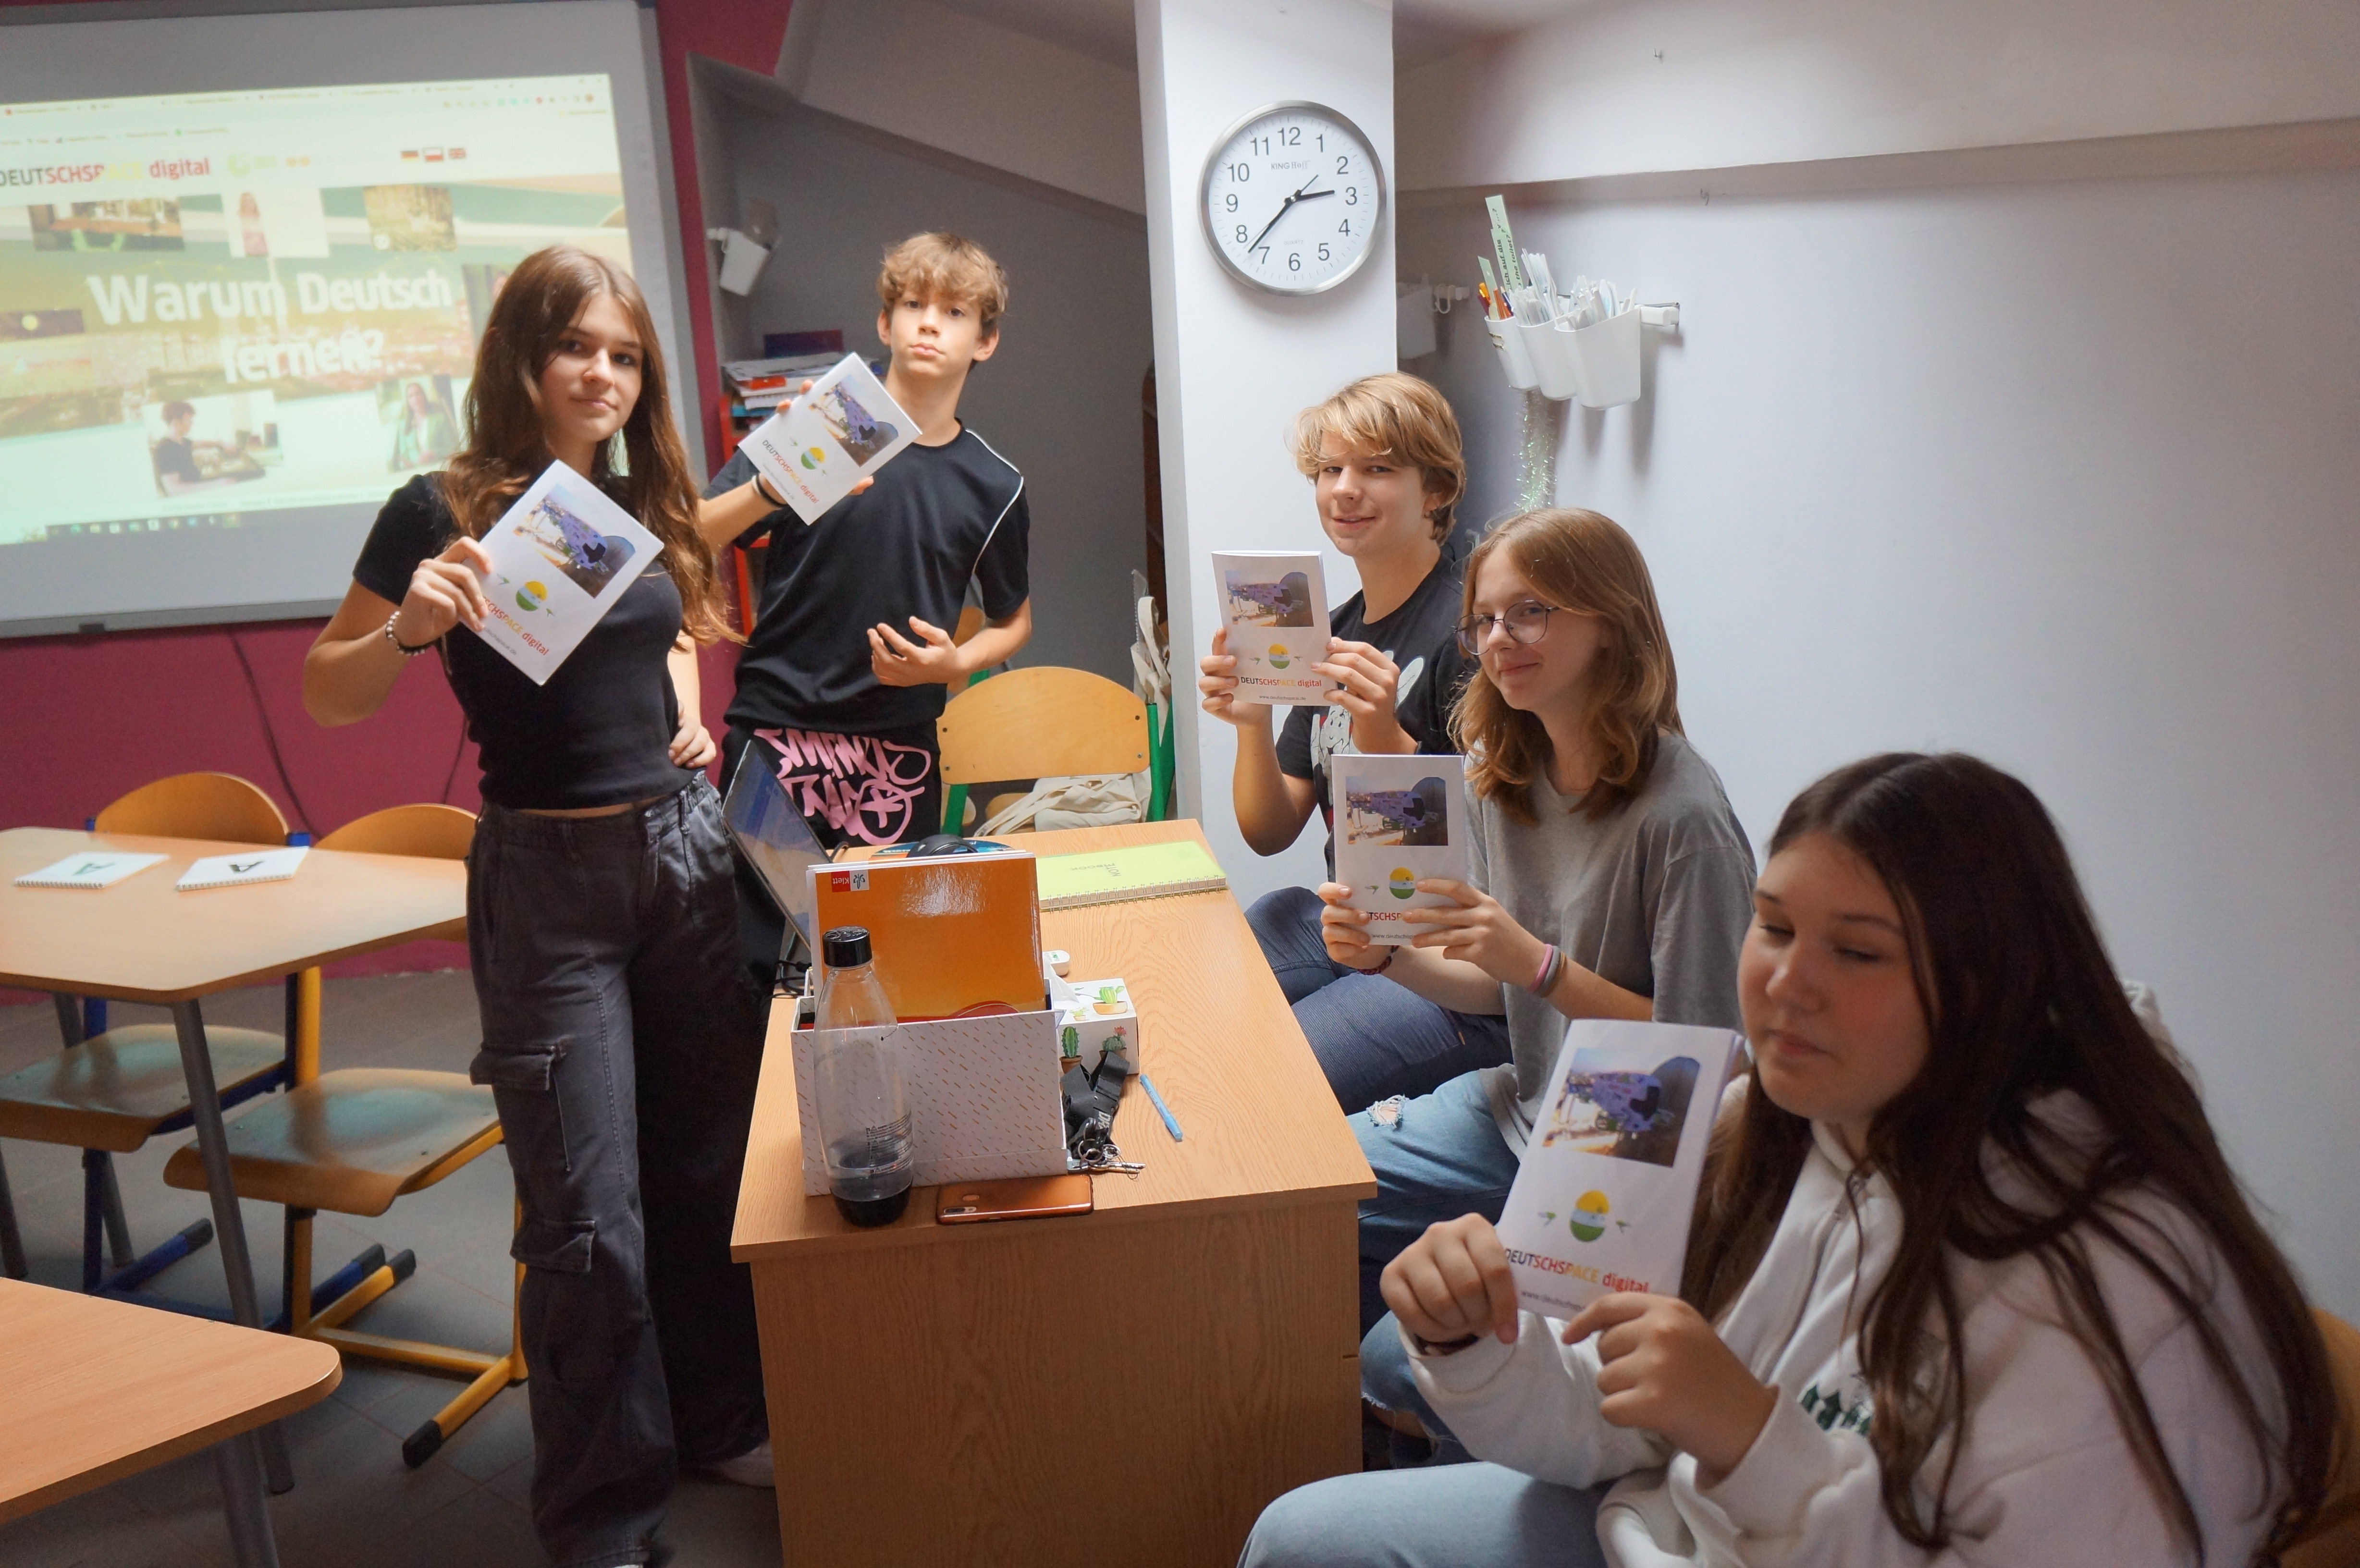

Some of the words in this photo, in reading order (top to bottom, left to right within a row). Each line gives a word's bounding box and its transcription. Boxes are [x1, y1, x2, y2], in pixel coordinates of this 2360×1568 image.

[1250, 136, 1269, 156] 11
[1278, 127, 1301, 146] 12
[1316, 134, 1324, 153] 1
[149, 157, 210, 181] digital
[1227, 163, 1250, 182] 10
[1271, 162, 1291, 170] KING
[1337, 156, 1349, 175] 2
[1226, 194, 1239, 212] 9
[1345, 187, 1358, 206] 3
[1236, 225, 1248, 243] 8
[1339, 219, 1351, 237] 4
[1258, 246, 1270, 264] 7
[1317, 243, 1330, 261] 5
[1289, 253, 1301, 271] 6
[87, 275, 287, 325] Warum
[295, 269, 452, 314] Deutsch
[800, 485, 820, 504] digital
[522, 632, 549, 656] digital
[1241, 676, 1296, 686] DEUTSCHSPACE
[1298, 679, 1322, 688] digital
[1602, 1273, 1649, 1293] digital
